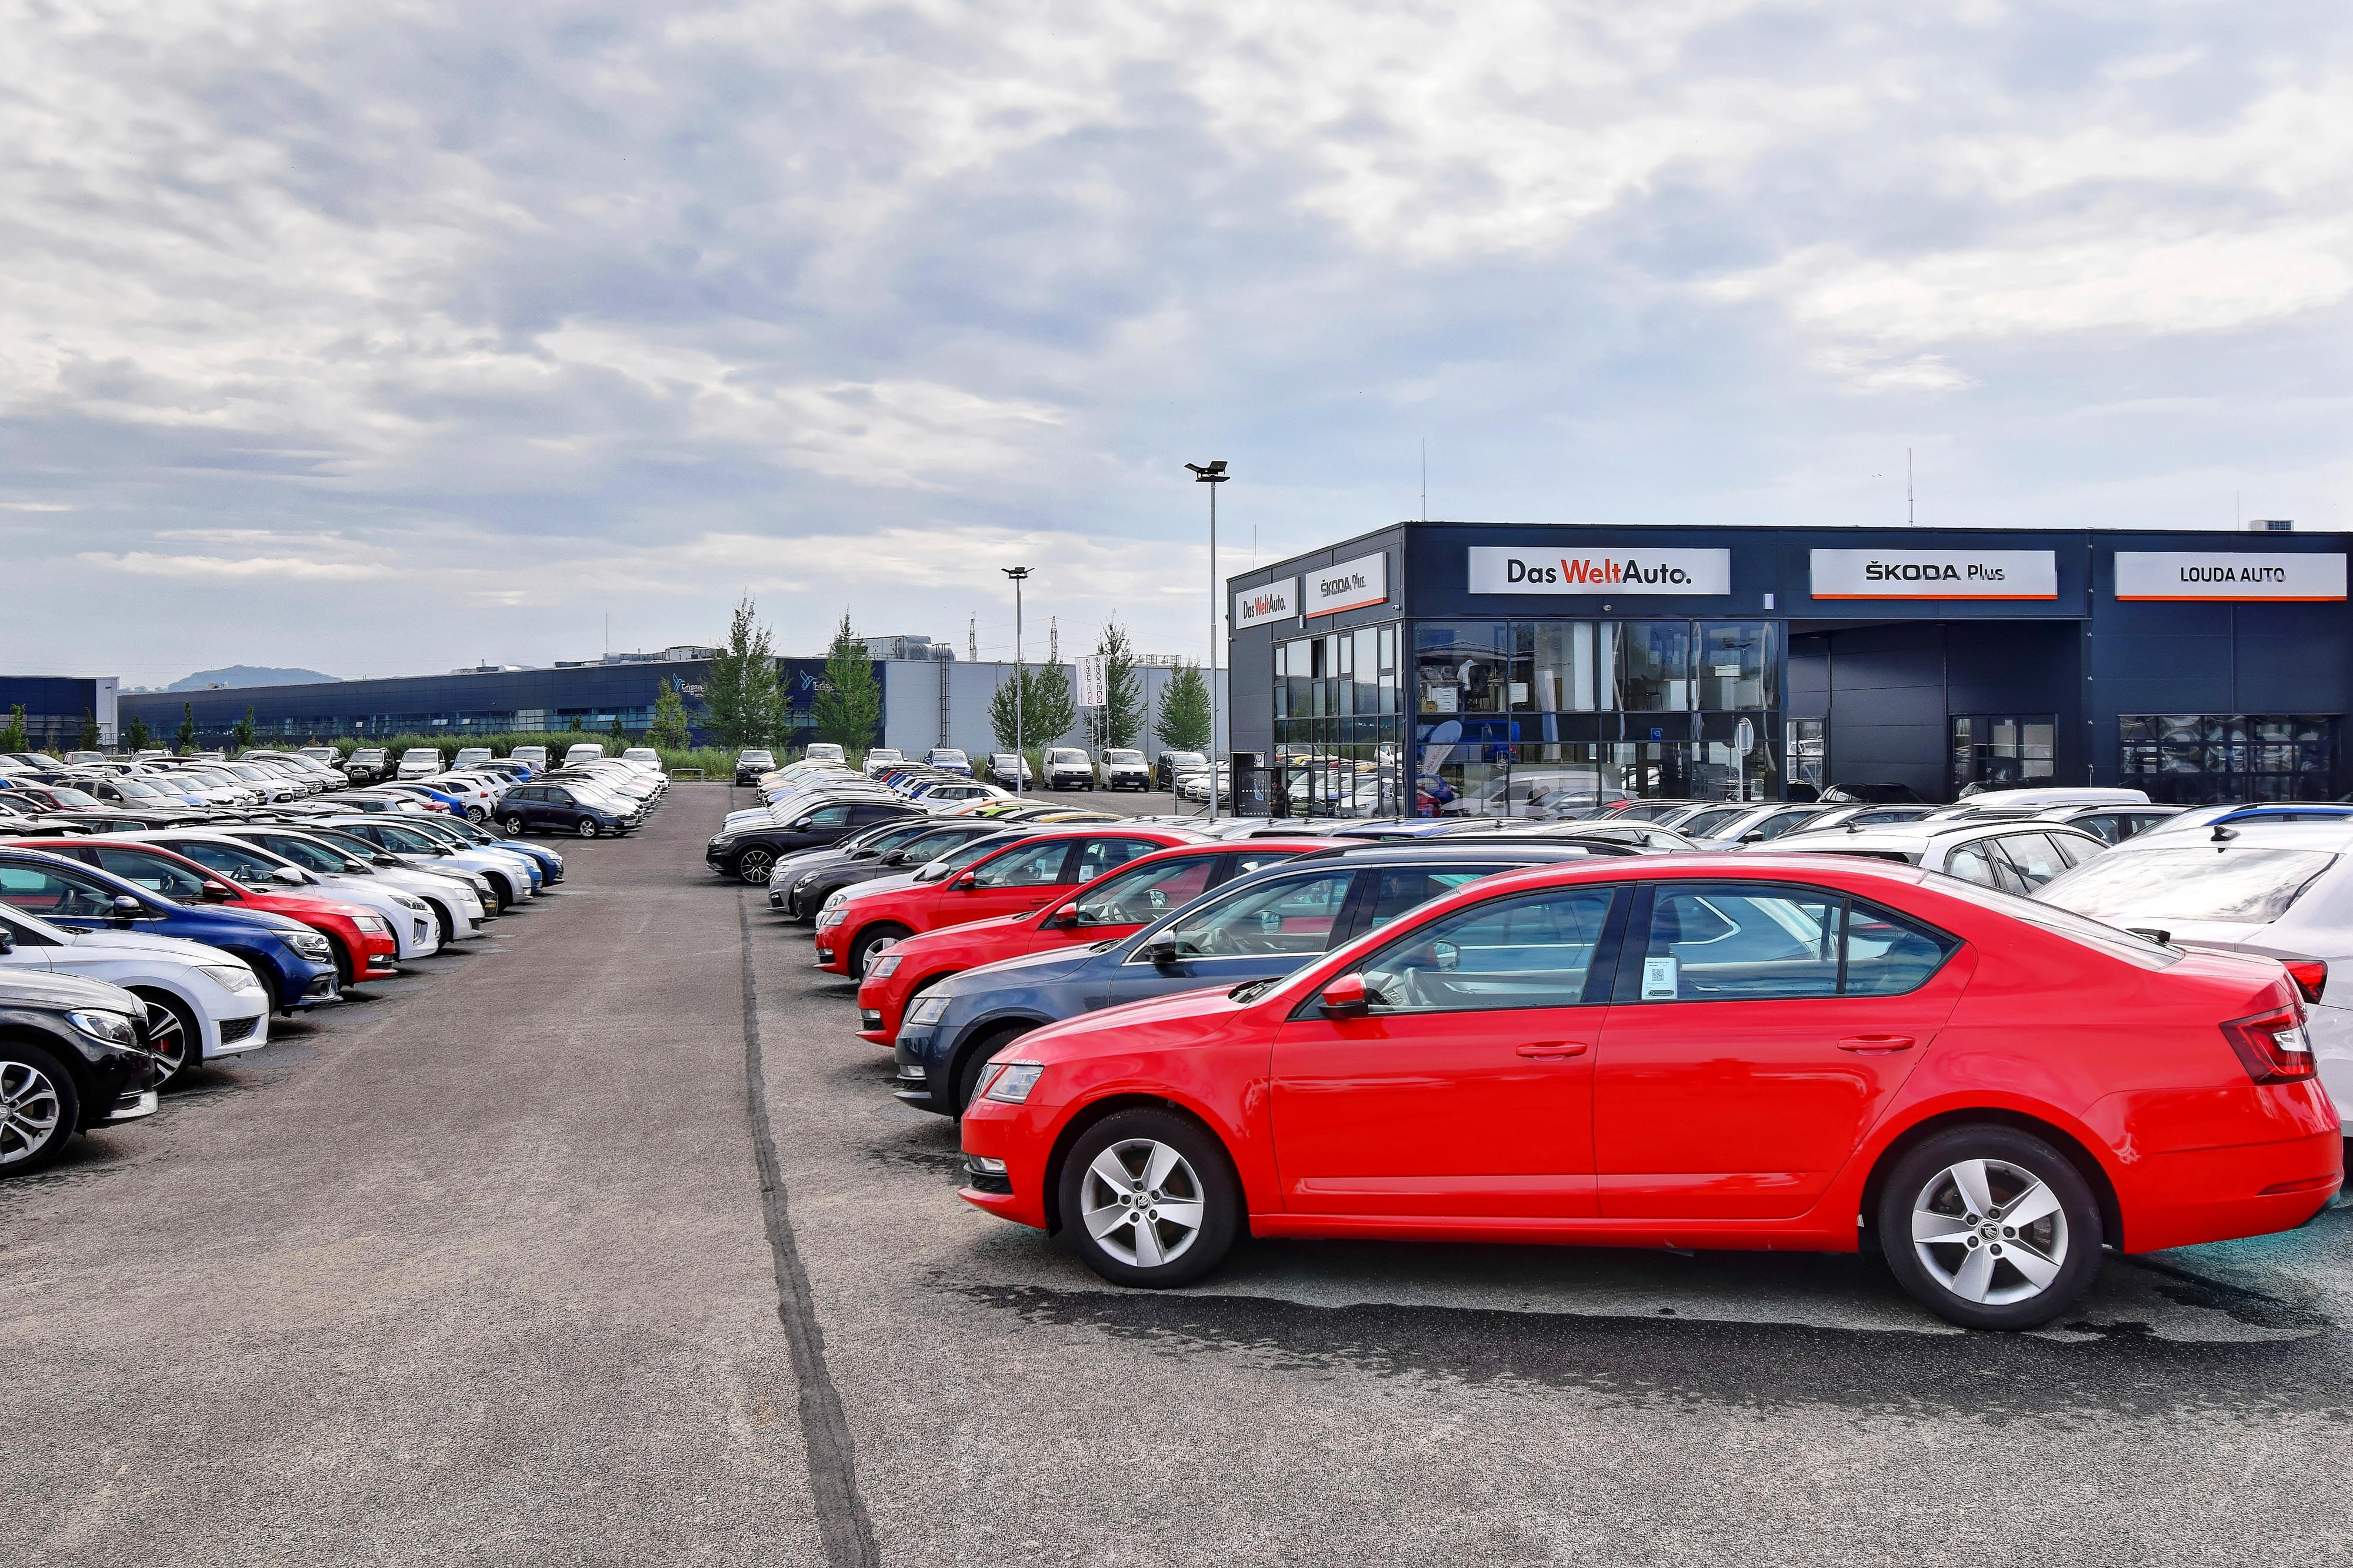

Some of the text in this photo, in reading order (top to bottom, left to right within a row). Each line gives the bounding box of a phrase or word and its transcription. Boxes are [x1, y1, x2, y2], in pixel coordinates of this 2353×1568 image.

[1507, 559, 1556, 583] Das
[1865, 561, 2005, 581] ŠKODA Plus
[2181, 567, 2286, 583] LOUDA AUTO
[1320, 572, 1367, 597] ŠKODA Plus
[1243, 600, 1254, 619] Das
